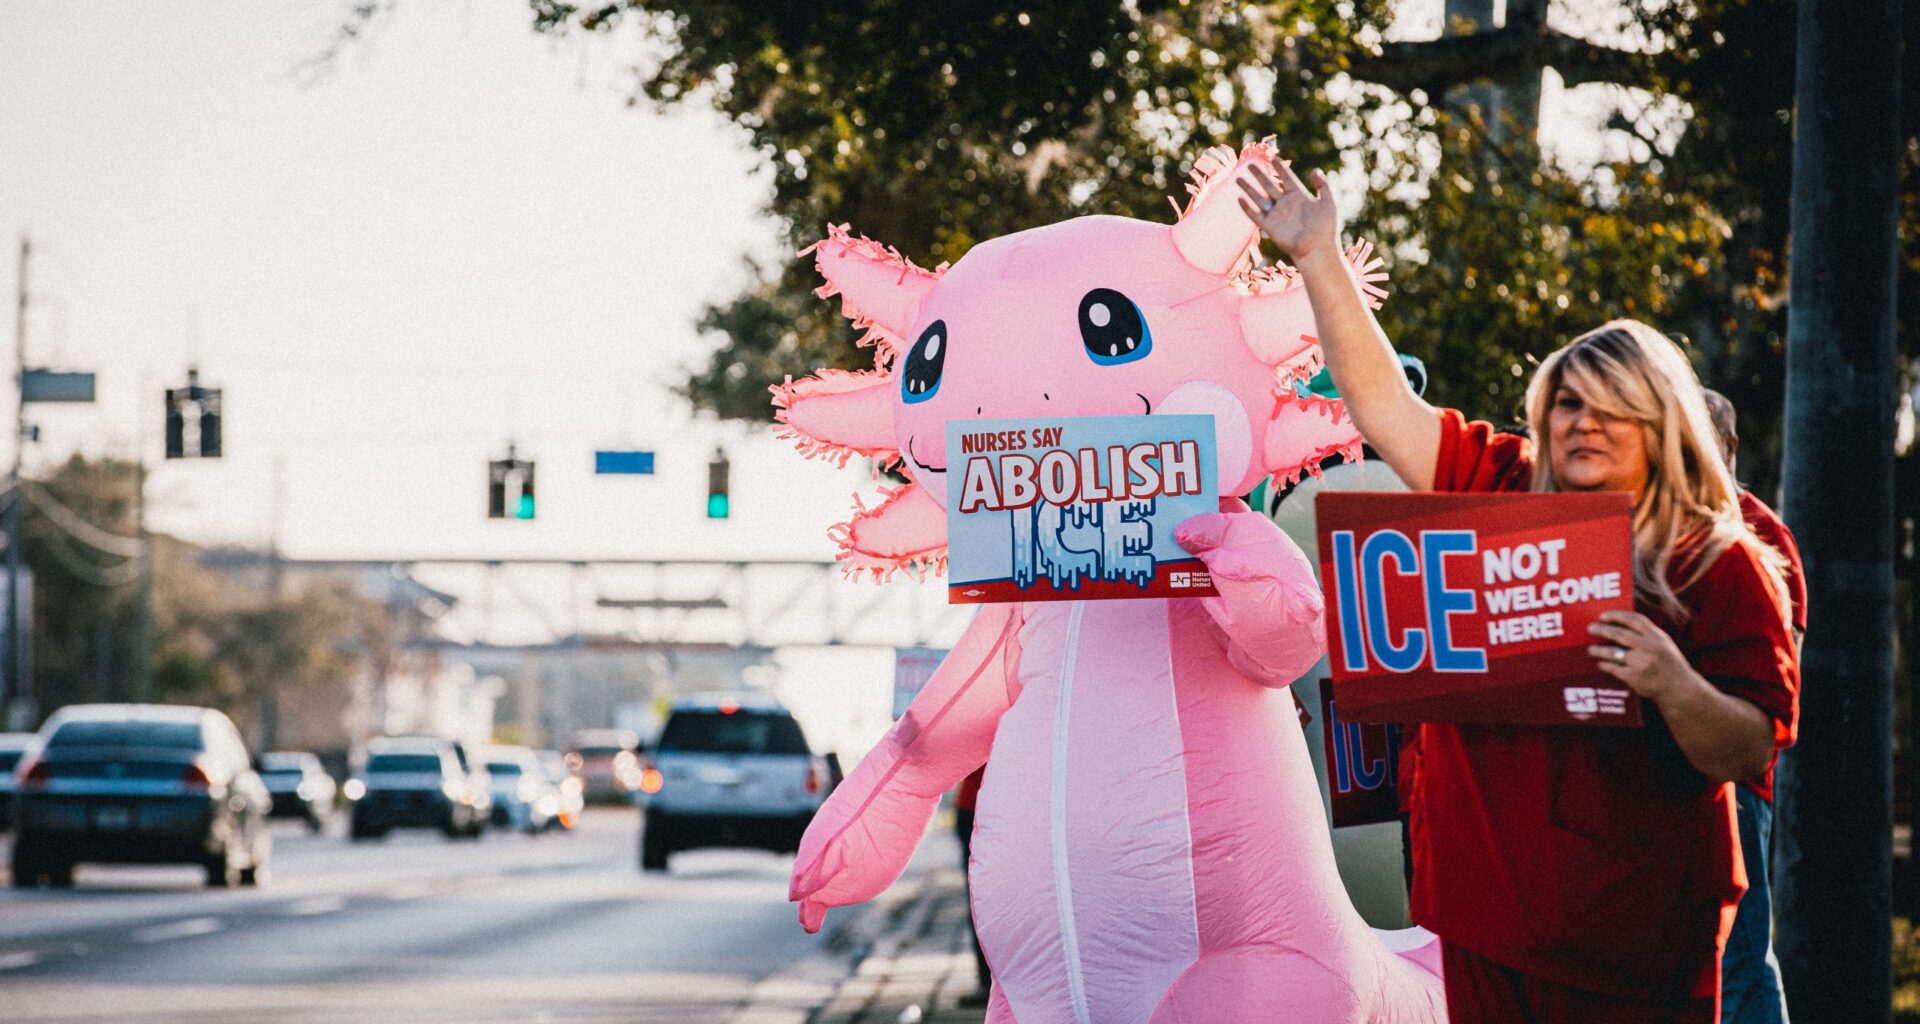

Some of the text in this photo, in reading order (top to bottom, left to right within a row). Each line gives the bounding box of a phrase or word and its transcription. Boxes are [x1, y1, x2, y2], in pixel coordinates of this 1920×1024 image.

[962, 427, 1063, 453] NURSES SAY
[959, 440, 1202, 513] ABOLISH
[1010, 498, 1156, 591] ICE
[1482, 538, 1566, 584] NOT
[1331, 528, 1488, 673] ICE
[1484, 572, 1621, 614] WELCOME
[1487, 612, 1564, 646] HERE!
